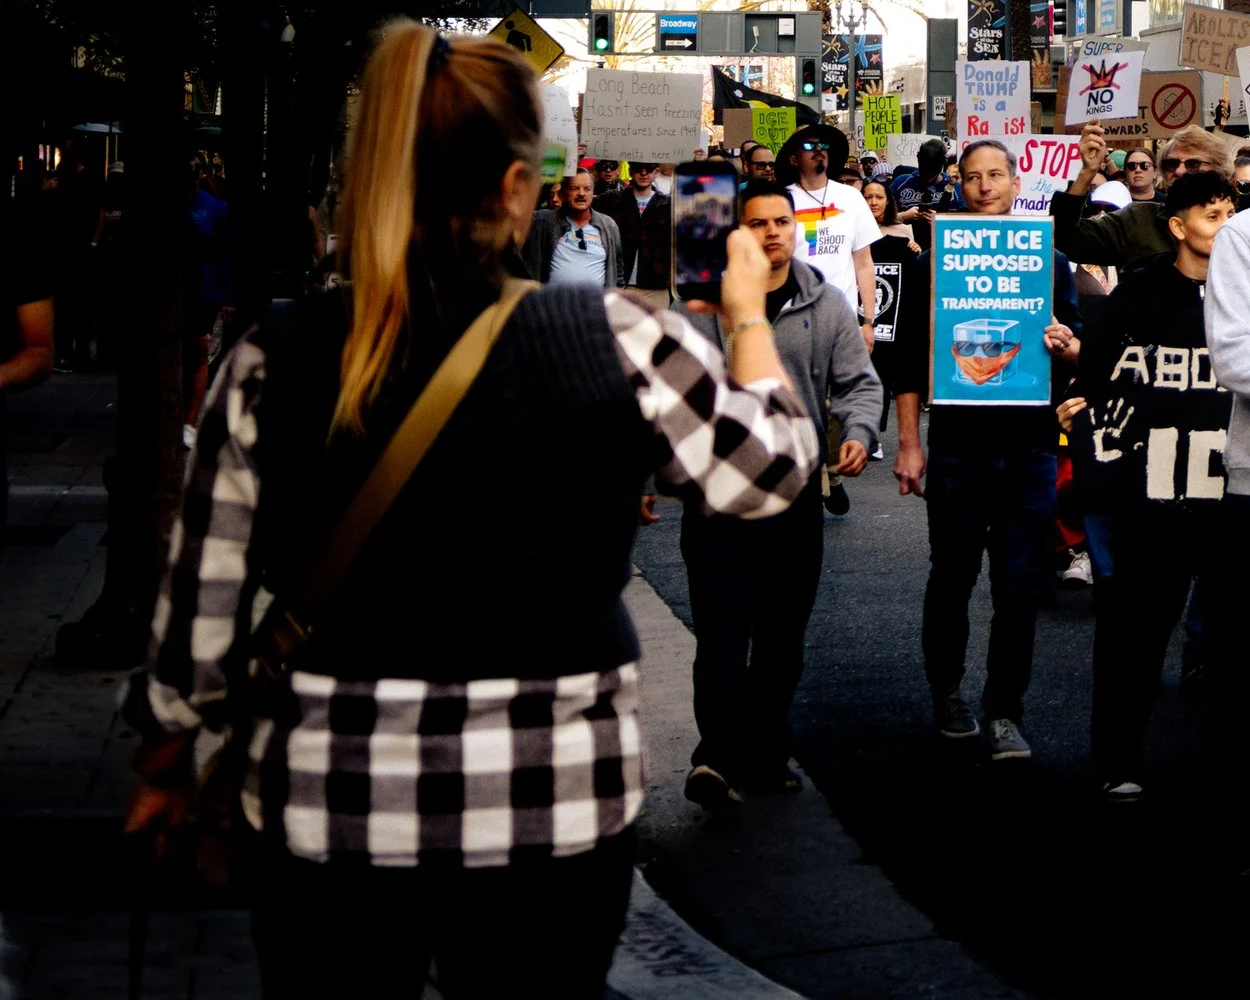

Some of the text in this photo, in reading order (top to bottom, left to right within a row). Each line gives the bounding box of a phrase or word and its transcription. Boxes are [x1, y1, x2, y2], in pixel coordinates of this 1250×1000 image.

[660, 19, 697, 29] Broadway
[969, 27, 1003, 39] Stars
[973, 41, 1000, 53] SEA
[1084, 41, 1123, 55] SUPER
[821, 62, 847, 71] Stars
[964, 64, 1020, 82] Donald
[587, 73, 670, 102] Long Beach
[965, 82, 1018, 96] TRUMP
[868, 96, 894, 110] HOT
[1087, 89, 1114, 106] NO
[995, 100, 1007, 111] a
[1086, 105, 1113, 116] KINGS
[634, 105, 659, 118] seen
[664, 103, 700, 126] freezing
[865, 110, 897, 123] PEOPLE
[584, 119, 653, 137] Temperatures
[656, 127, 676, 137] since
[756, 127, 788, 140] OUT
[872, 123, 898, 135] MELT
[1101, 122, 1148, 135] OWARDS
[876, 136, 887, 149] IC
[1019, 139, 1081, 179] STOP
[1031, 178, 1055, 193] the
[819, 227, 829, 236] WE
[819, 235, 845, 245] SHOOT
[943, 228, 1042, 249] ISN'T ICE
[818, 245, 839, 255] BACK
[943, 254, 1043, 271] SUPPOSED
[965, 276, 1020, 293] TO BE
[941, 297, 1044, 310] TRANSPARENT?
[1110, 345, 1227, 391] ABO
